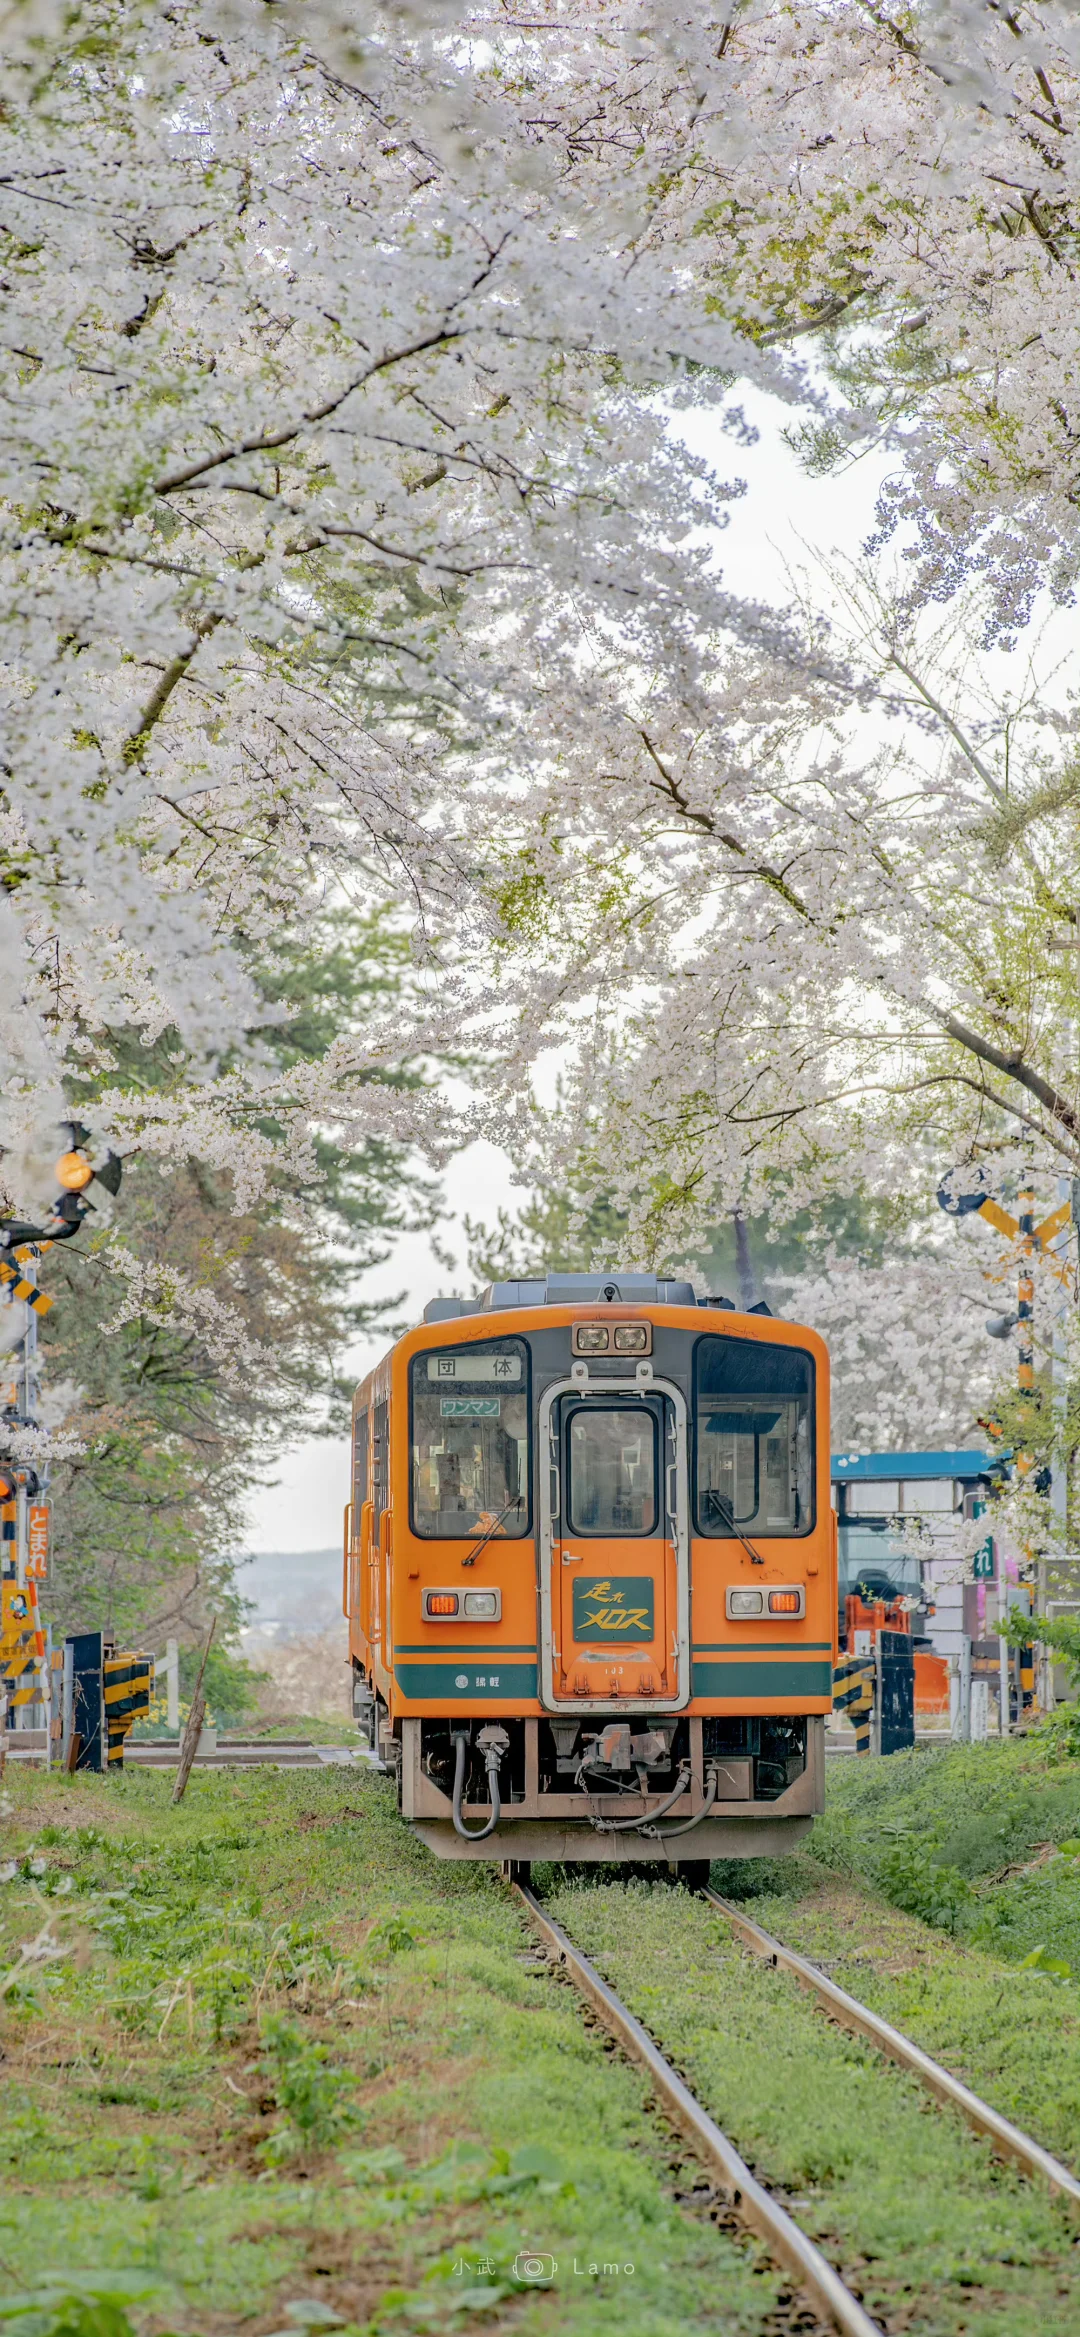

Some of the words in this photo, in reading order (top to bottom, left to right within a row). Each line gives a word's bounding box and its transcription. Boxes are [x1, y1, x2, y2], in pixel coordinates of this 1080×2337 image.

[437, 1358, 513, 1377] 団体
[443, 1401, 498, 1415] ワンマン
[30, 1511, 47, 1572] とまれ
[578, 1580, 625, 1604] 走れ
[576, 1608, 652, 1631] メロス
